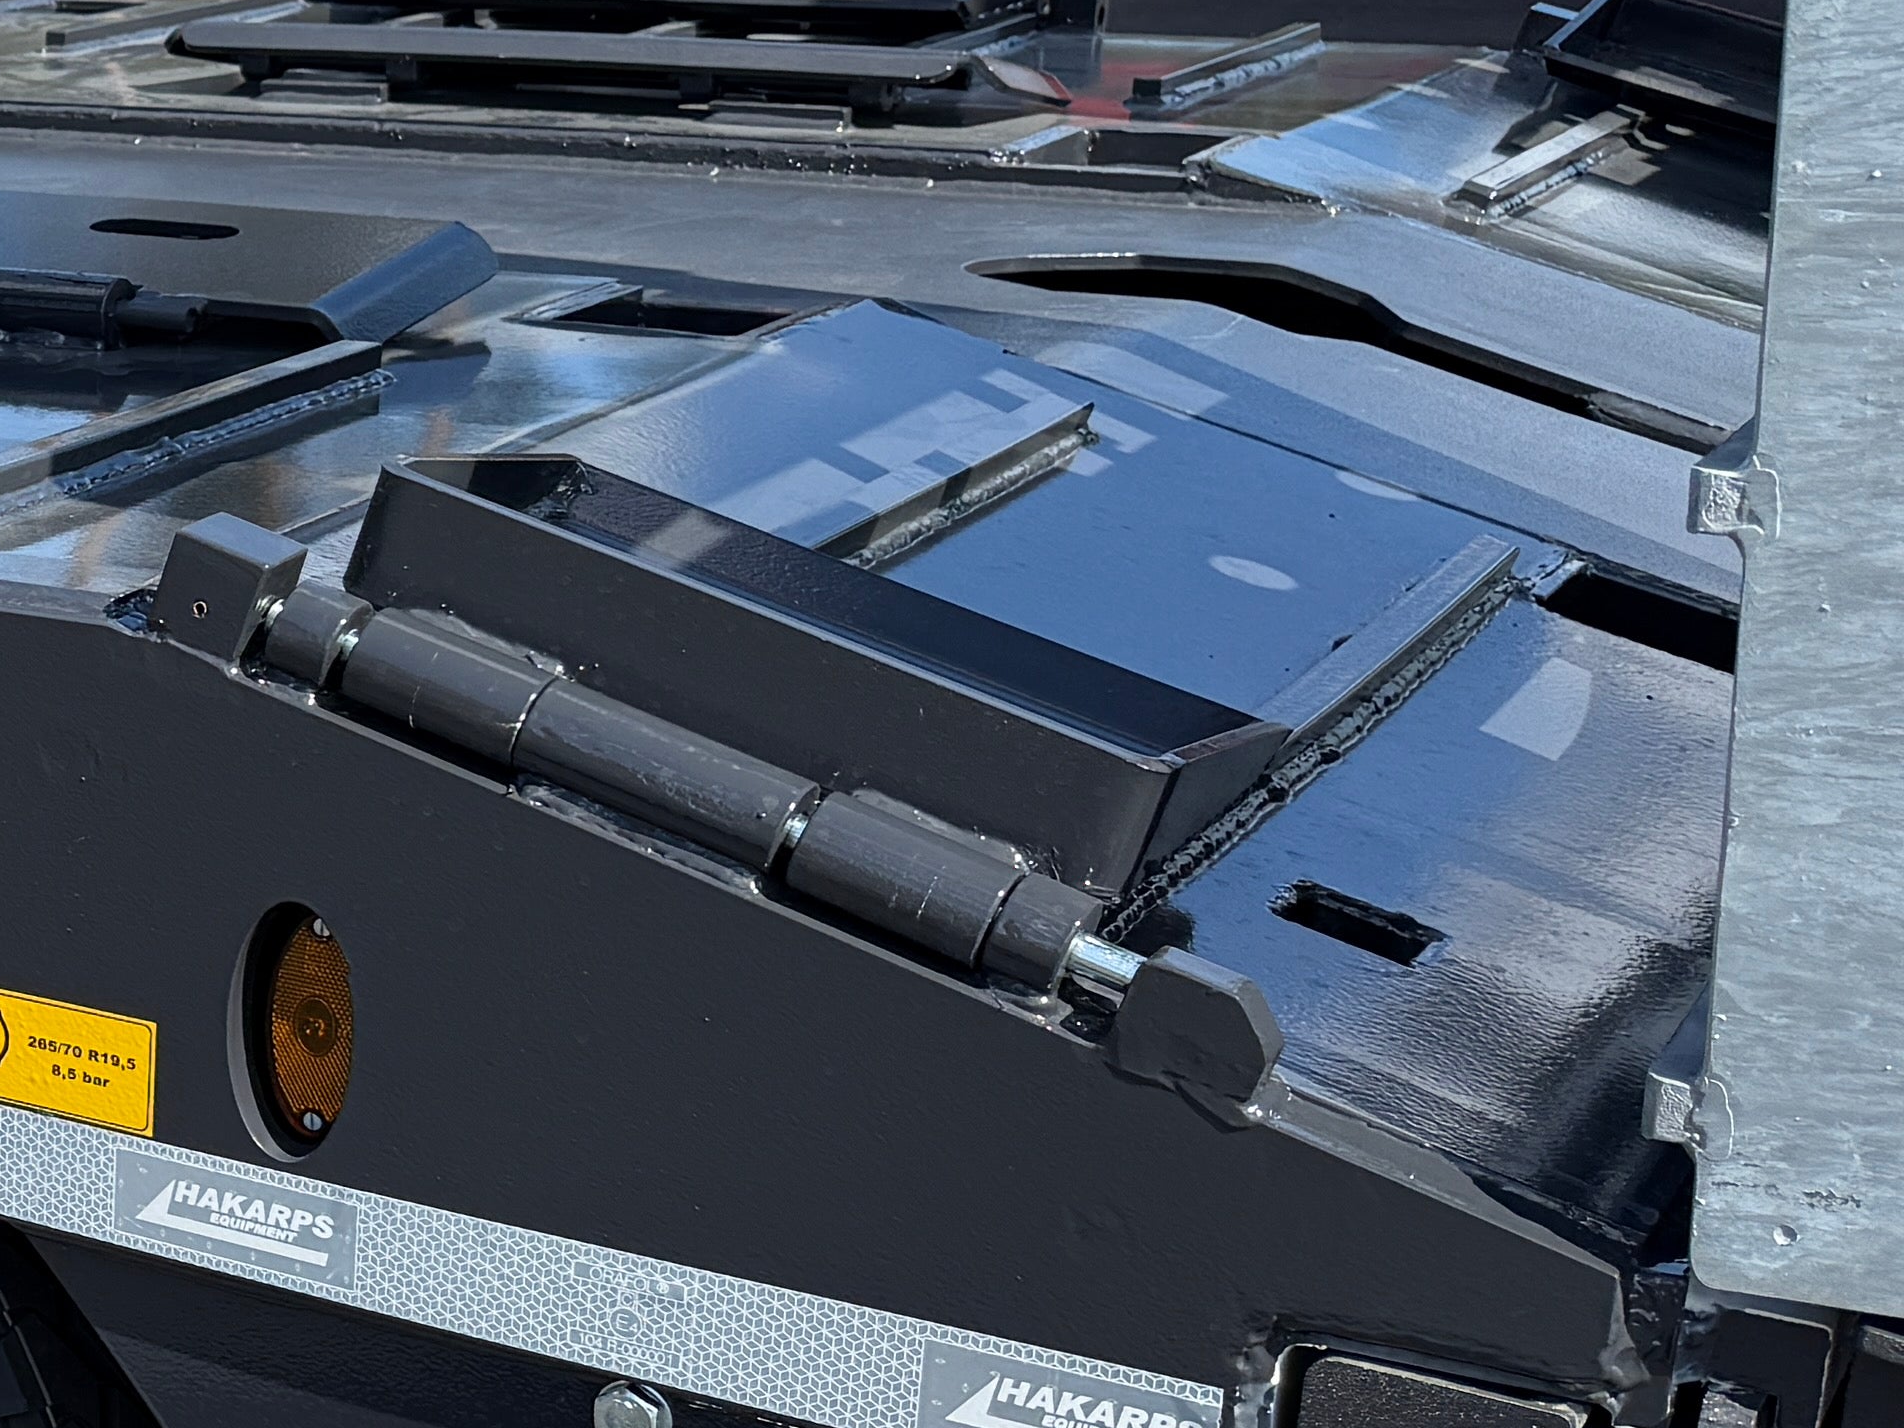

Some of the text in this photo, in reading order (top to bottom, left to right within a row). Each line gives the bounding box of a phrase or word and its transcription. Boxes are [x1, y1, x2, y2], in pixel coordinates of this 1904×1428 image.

[28, 1035, 137, 1071] 265/70 R19,5
[51, 1064, 111, 1088] 8,5 bar
[174, 1180, 335, 1239] HAKARPS
[209, 1212, 297, 1243] EQUIPMENT
